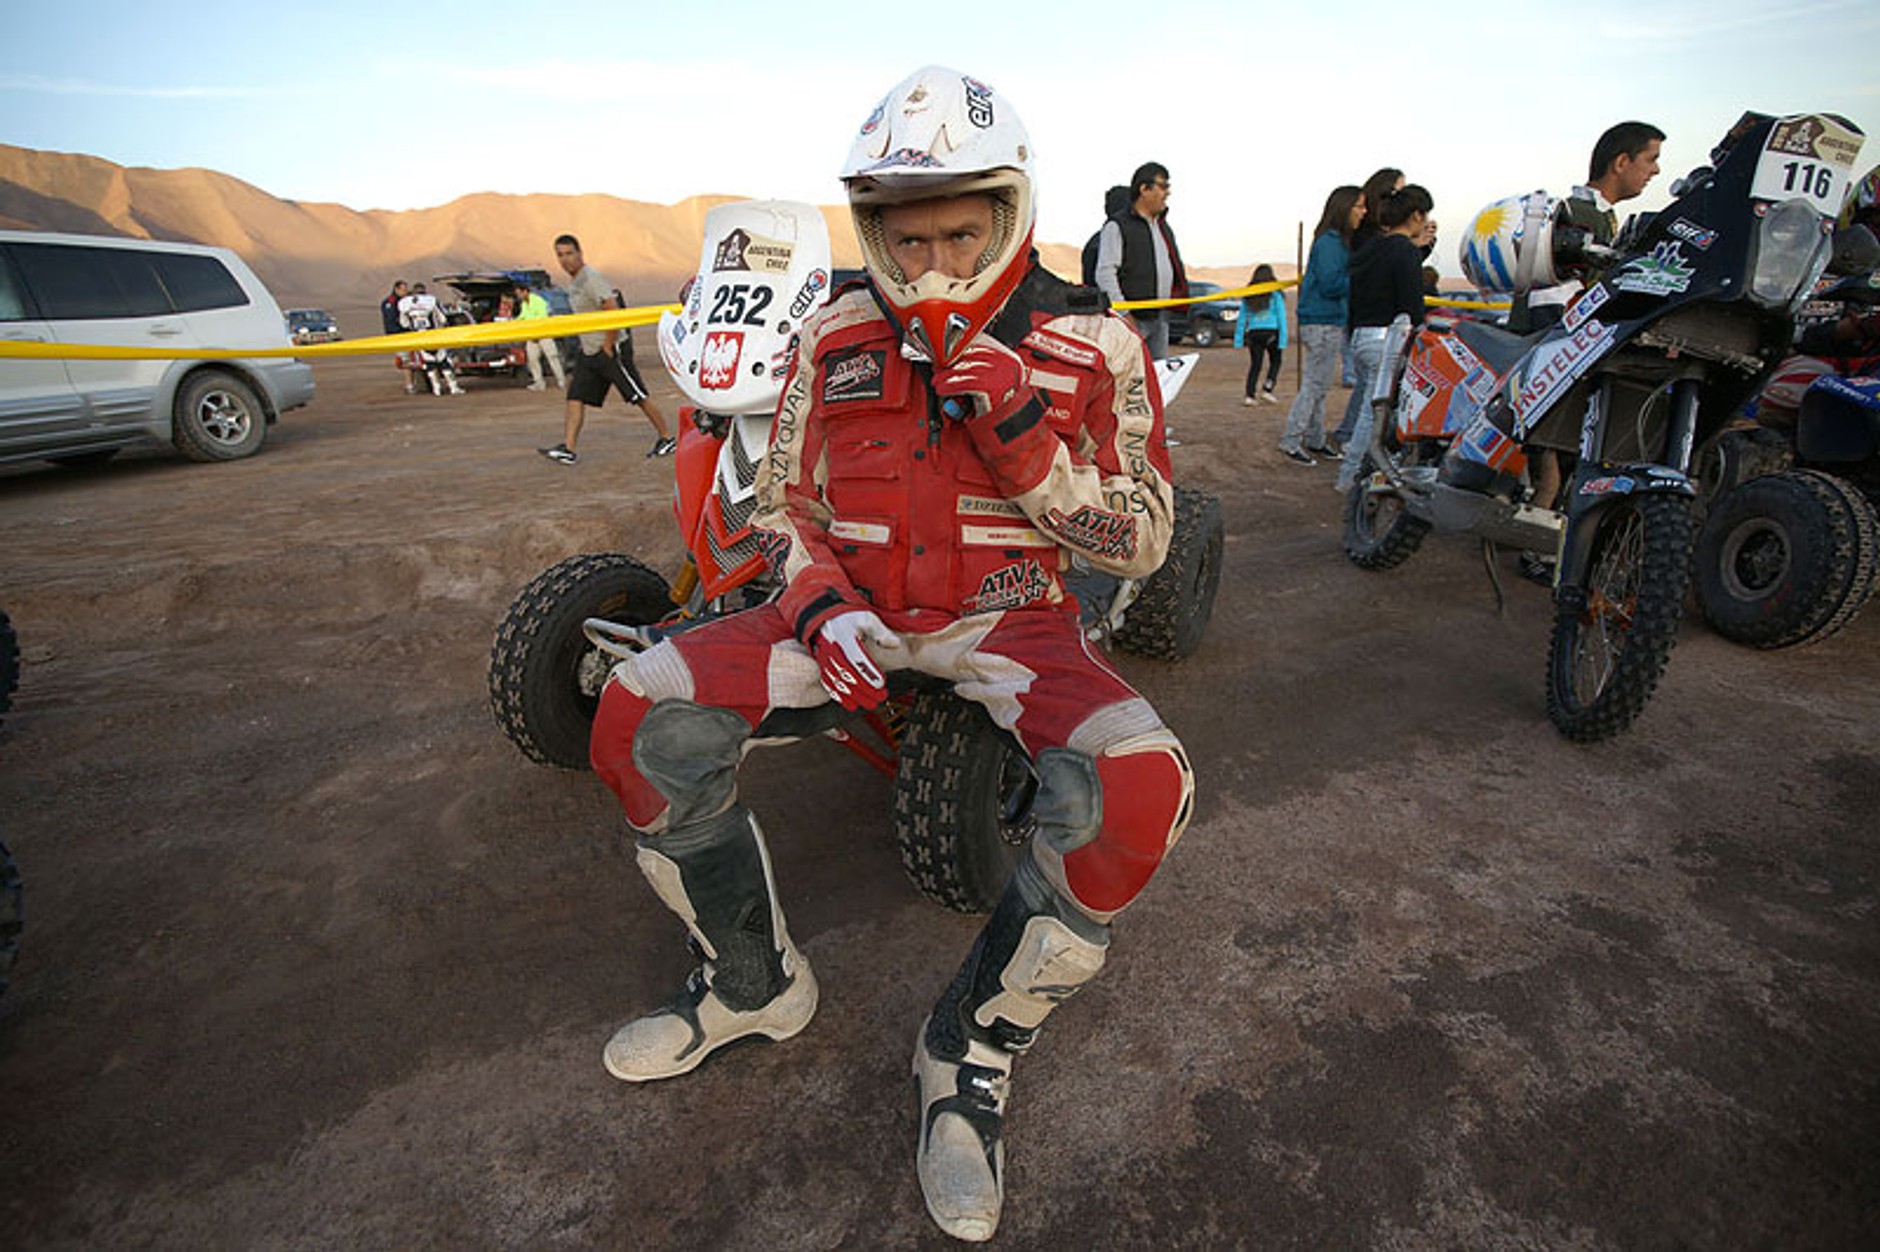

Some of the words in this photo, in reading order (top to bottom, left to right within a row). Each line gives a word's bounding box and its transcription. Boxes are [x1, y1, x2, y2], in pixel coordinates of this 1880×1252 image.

[963, 83, 994, 129] elf
[1783, 162, 1833, 199] 116
[707, 284, 774, 327] 252
[1512, 319, 1606, 417] INSTELEC
[1068, 509, 1125, 535] ATV
[979, 561, 1027, 597] ATV
